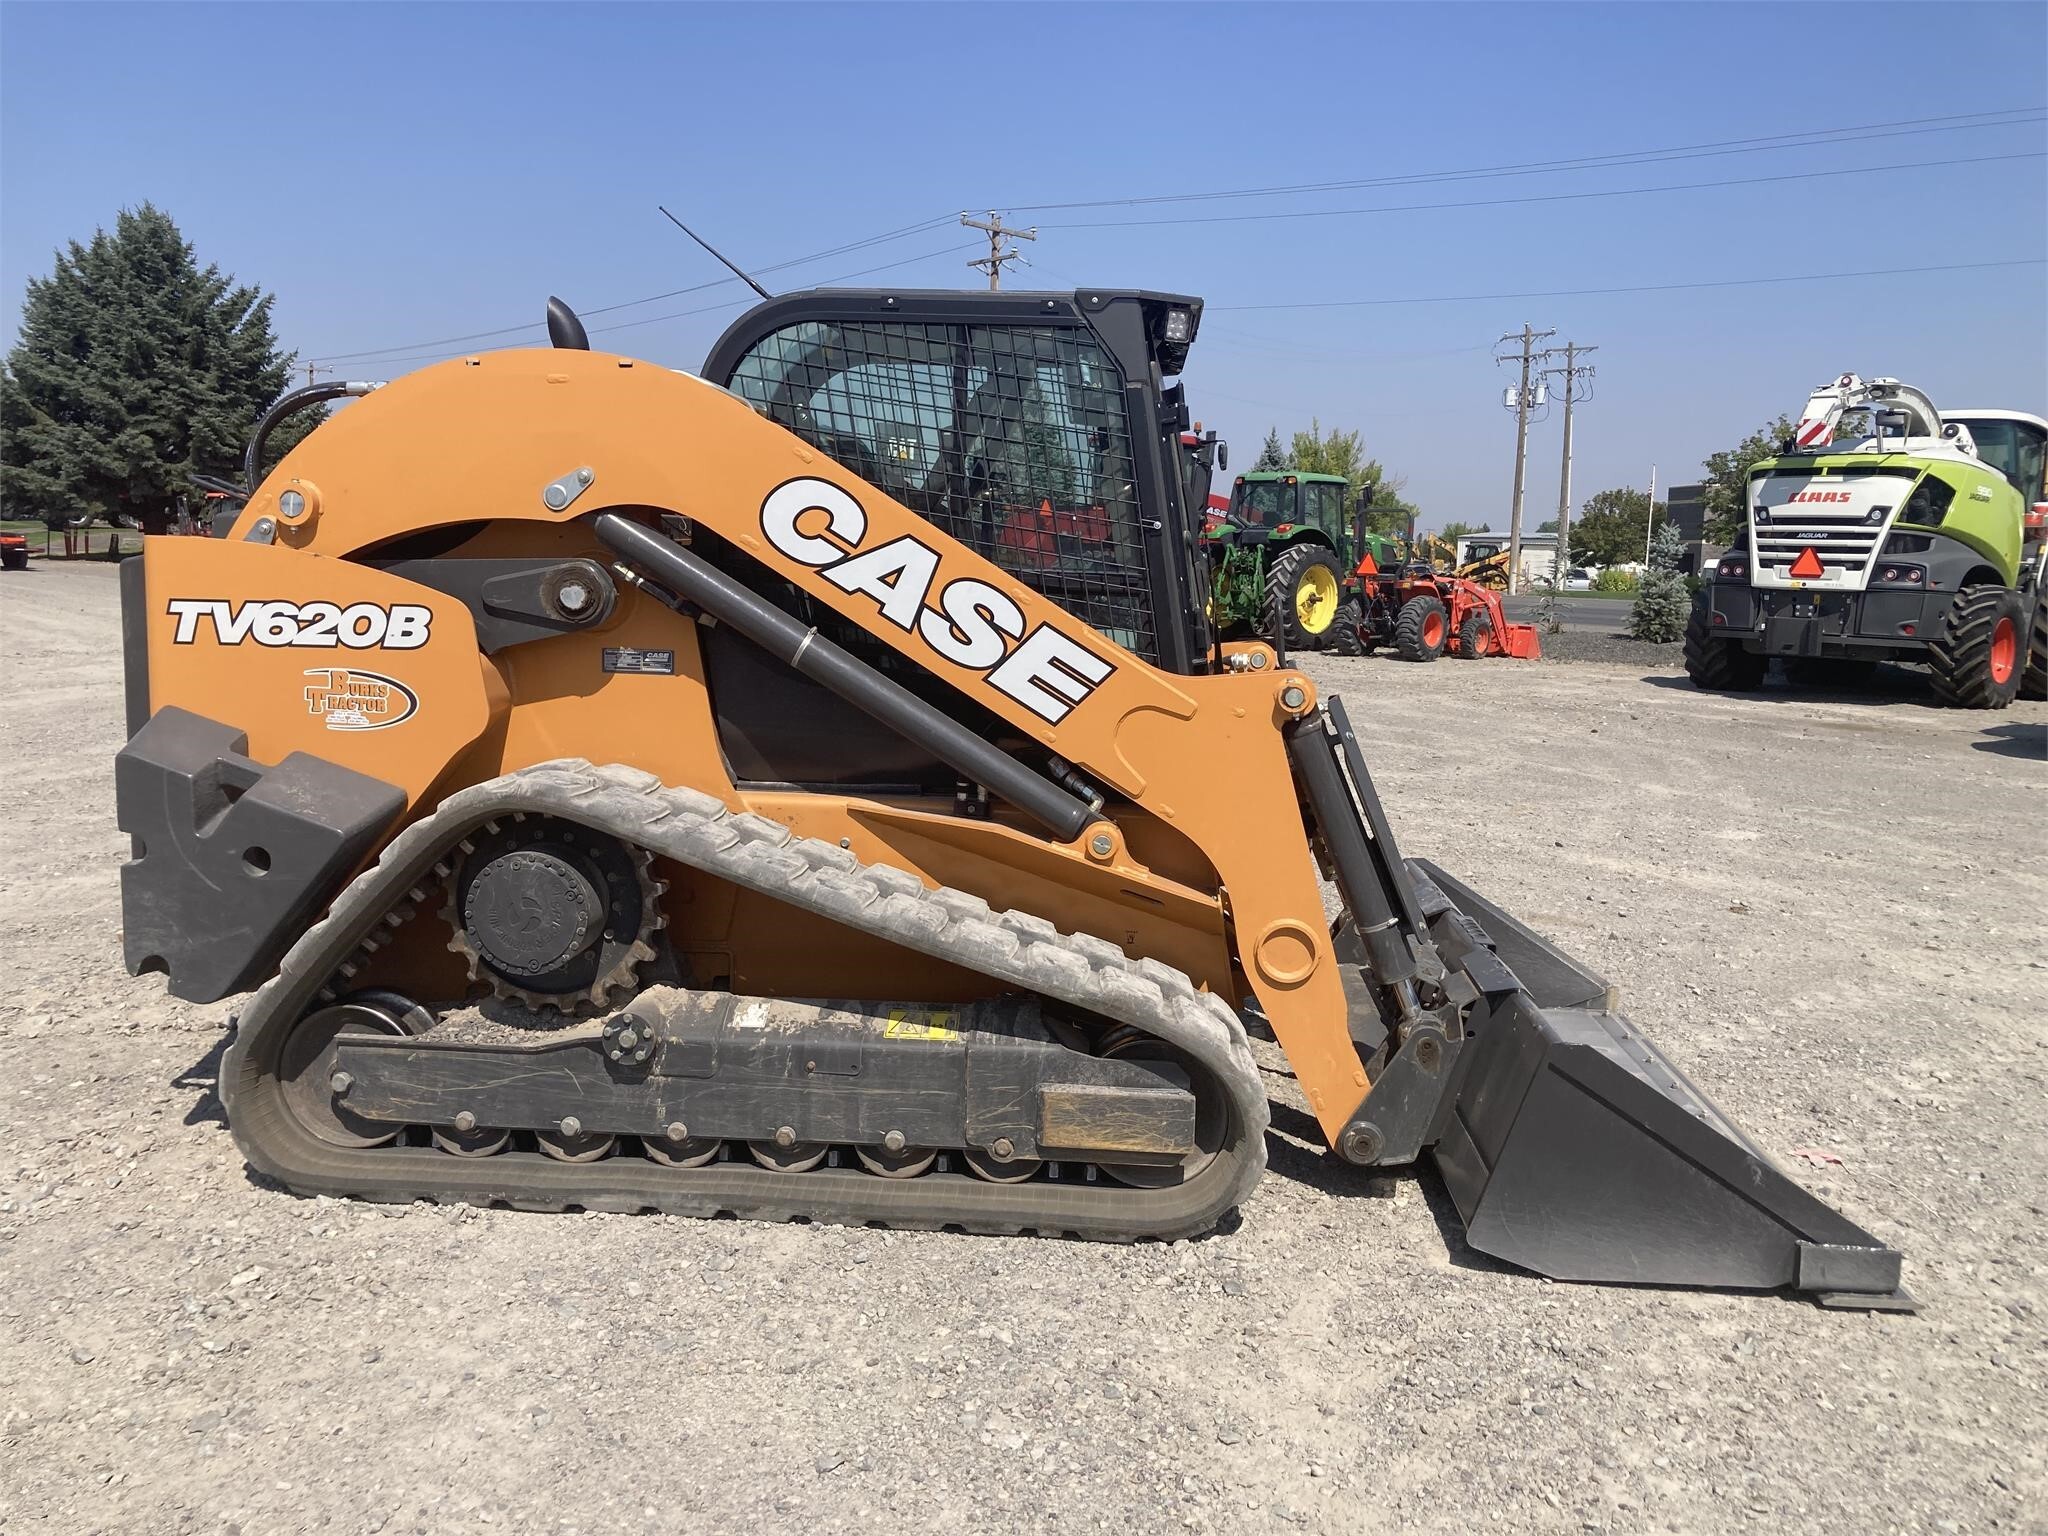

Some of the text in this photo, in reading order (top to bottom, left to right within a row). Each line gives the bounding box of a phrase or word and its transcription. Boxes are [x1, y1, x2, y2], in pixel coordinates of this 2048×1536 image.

[888, 437, 917, 461] CAT
[1788, 492, 1852, 503] CLAAS
[1206, 507, 1228, 518] ASE
[759, 475, 1118, 727] CASE
[166, 598, 434, 651] TV620B
[330, 670, 389, 698] BURKS
[306, 687, 388, 713] TRACTOR
